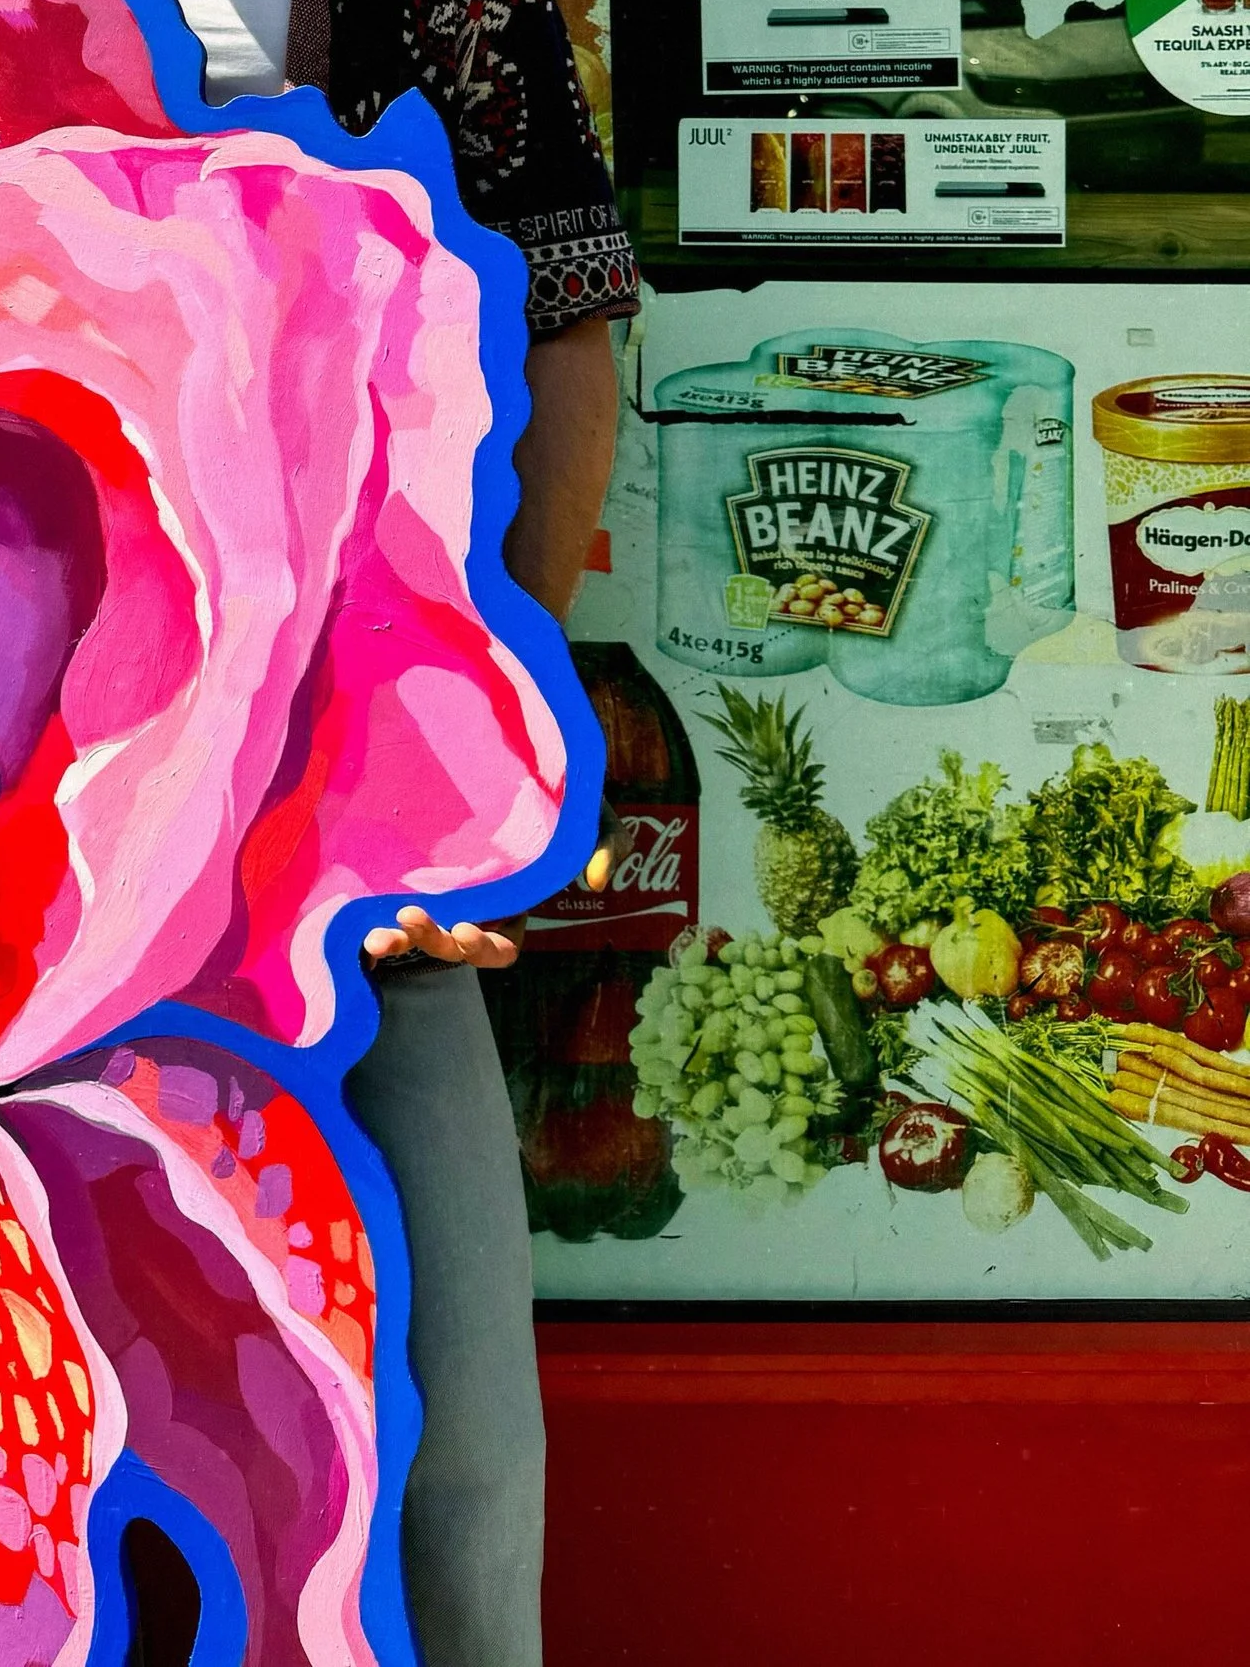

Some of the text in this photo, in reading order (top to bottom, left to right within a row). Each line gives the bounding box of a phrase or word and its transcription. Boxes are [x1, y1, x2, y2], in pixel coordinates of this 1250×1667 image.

[1192, 25, 1243, 37] SMASH
[1154, 40, 1215, 51] TEQUILA
[732, 62, 932, 74] WARNING: This product contains nicotine
[742, 74, 923, 86] which is highly addictive substance.
[925, 134, 1050, 143] UNMISTAKABLY FRUIT,
[934, 145, 1041, 154] UNDENIABLY JUUL.
[518, 207, 584, 241] SPIRIT
[589, 205, 607, 229] OF
[834, 349, 956, 372] HEINZ
[792, 358, 967, 384] BEANZ
[768, 462, 887, 504] HEINZ
[744, 502, 910, 565] BEANZ
[751, 551, 781, 562] Baked
[838, 552, 896, 579] deliciously
[774, 561, 866, 580] rich sauce
[1149, 579, 1204, 595] Pralines
[1209, 583, 1220, 595] &
